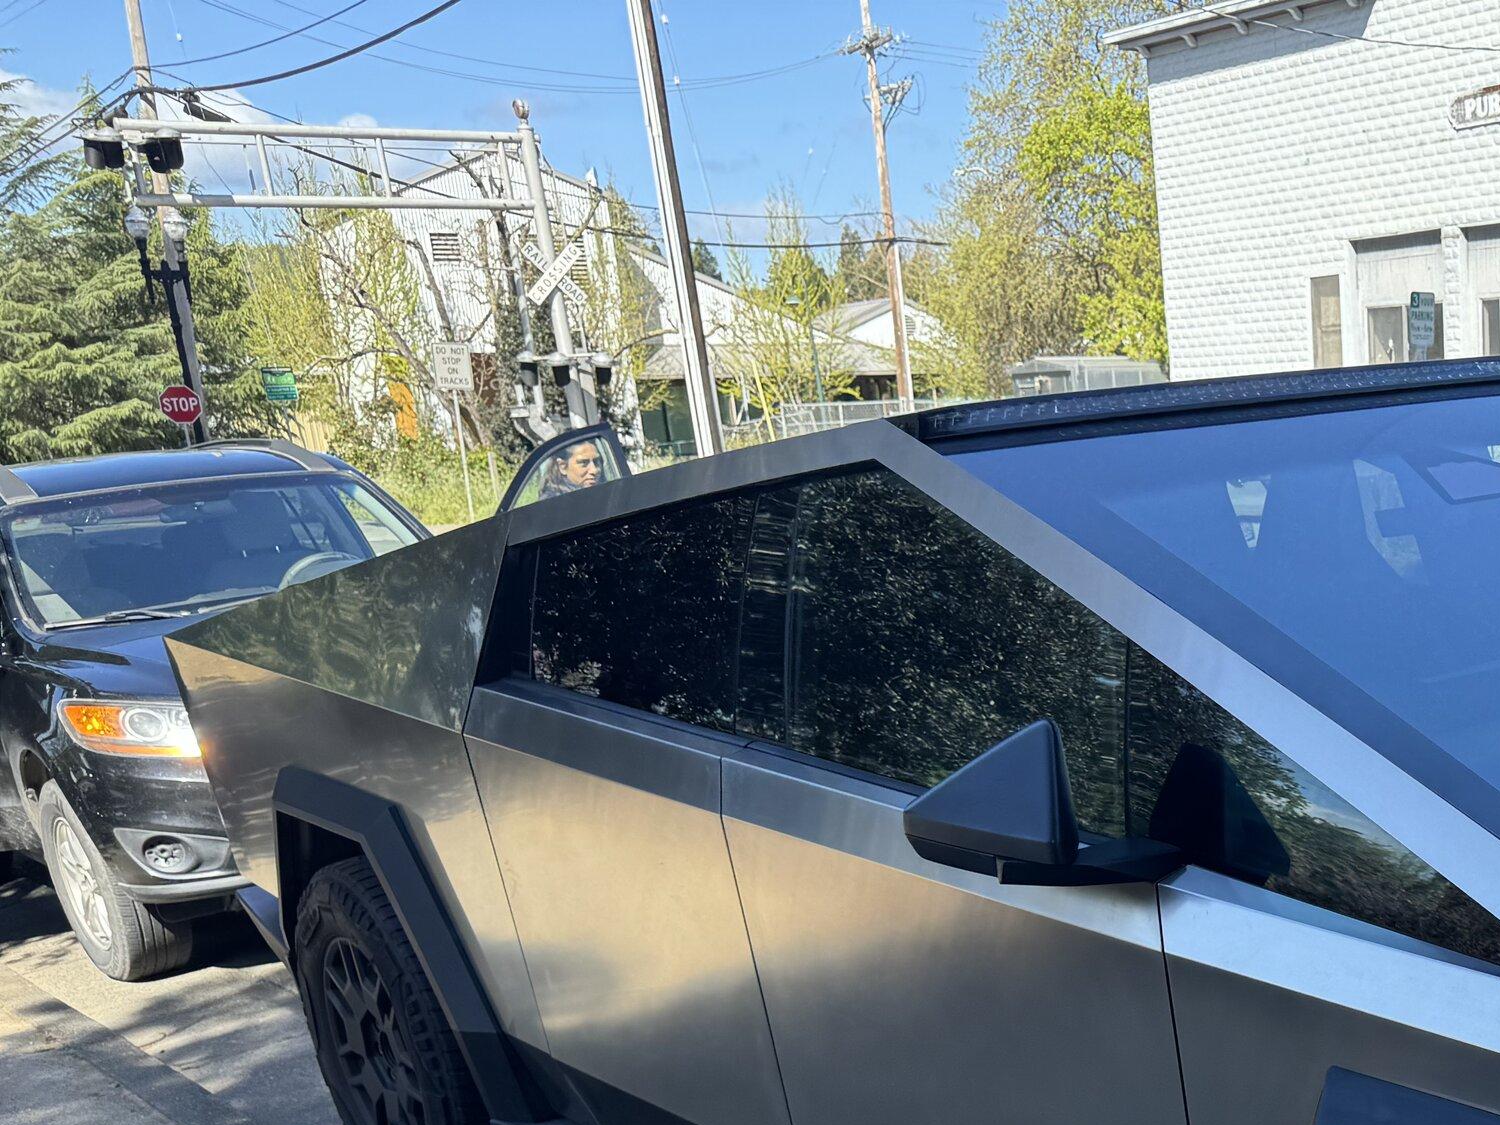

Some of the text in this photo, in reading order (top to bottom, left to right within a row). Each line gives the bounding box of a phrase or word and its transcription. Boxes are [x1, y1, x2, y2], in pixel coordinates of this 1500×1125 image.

[524, 245, 584, 302] RAIL ROAD
[532, 246, 577, 301] CROSSING
[1412, 293, 1419, 306] 3
[435, 347, 446, 355] DO
[162, 396, 198, 412] STOP
